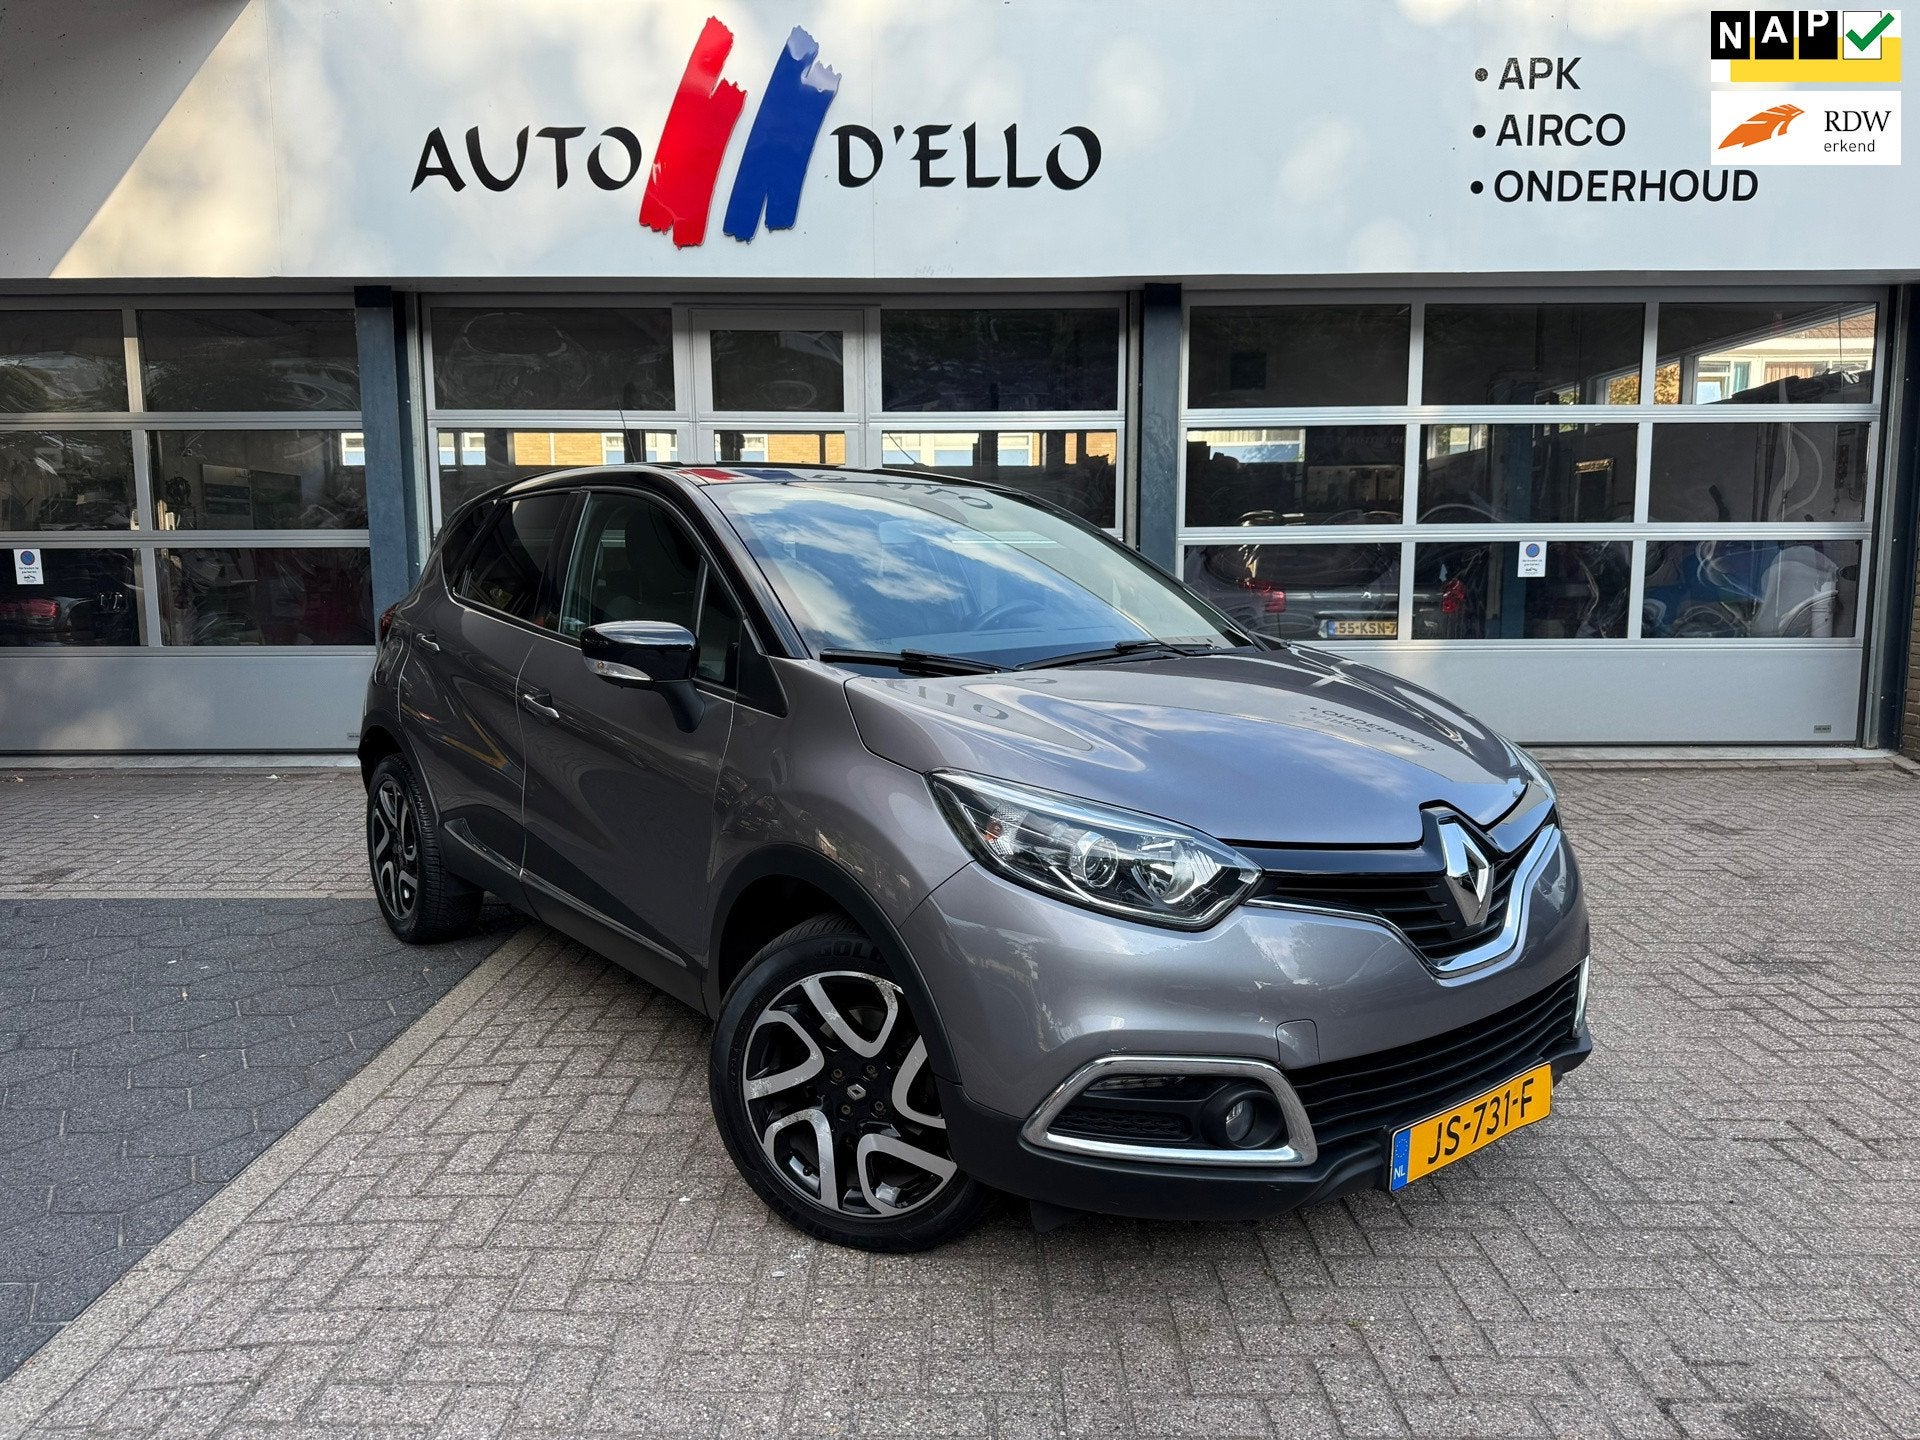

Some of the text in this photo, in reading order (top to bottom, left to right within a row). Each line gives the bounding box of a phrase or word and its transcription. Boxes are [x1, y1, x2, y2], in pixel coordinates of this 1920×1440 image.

[1498, 57, 1582, 90] APK
[1496, 113, 1626, 147] AIRCO
[411, 122, 1102, 192] AUTO D'ELLO
[1494, 169, 1759, 203] ONDERHOUD
[1427, 1077, 1535, 1165] JS-731-F
[1394, 1165, 1406, 1180] NL
